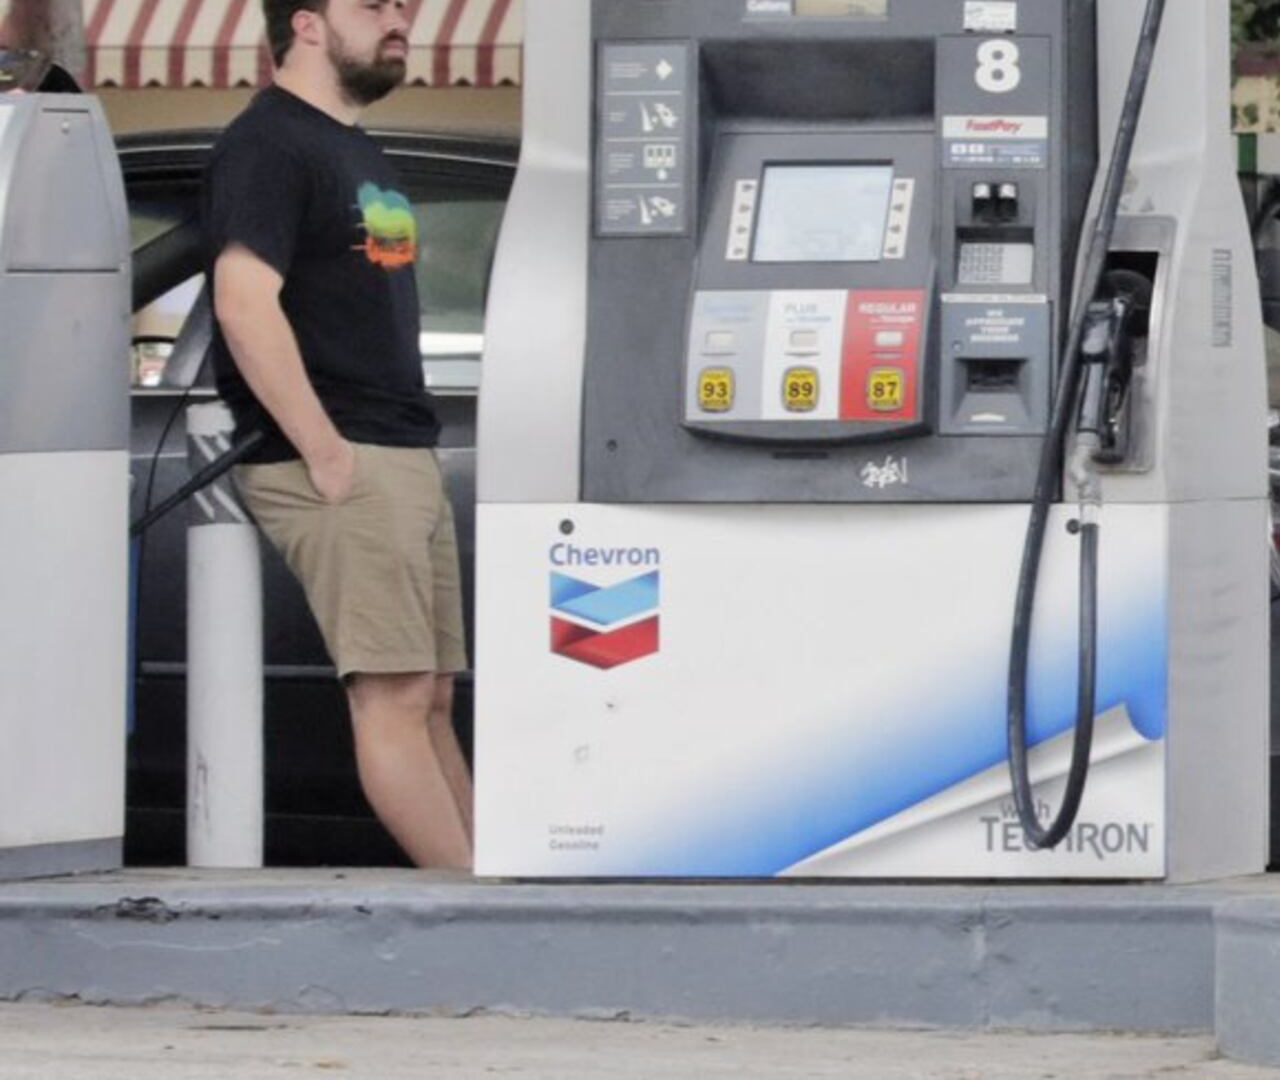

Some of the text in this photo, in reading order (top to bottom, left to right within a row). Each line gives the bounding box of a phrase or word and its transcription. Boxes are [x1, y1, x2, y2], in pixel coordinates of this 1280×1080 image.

[975, 39, 1021, 93] 8
[703, 381, 728, 398] 93
[788, 381, 814, 398] 89
[873, 381, 898, 397] 87
[549, 542, 660, 566] Chevron
[1001, 799, 1050, 819] wh
